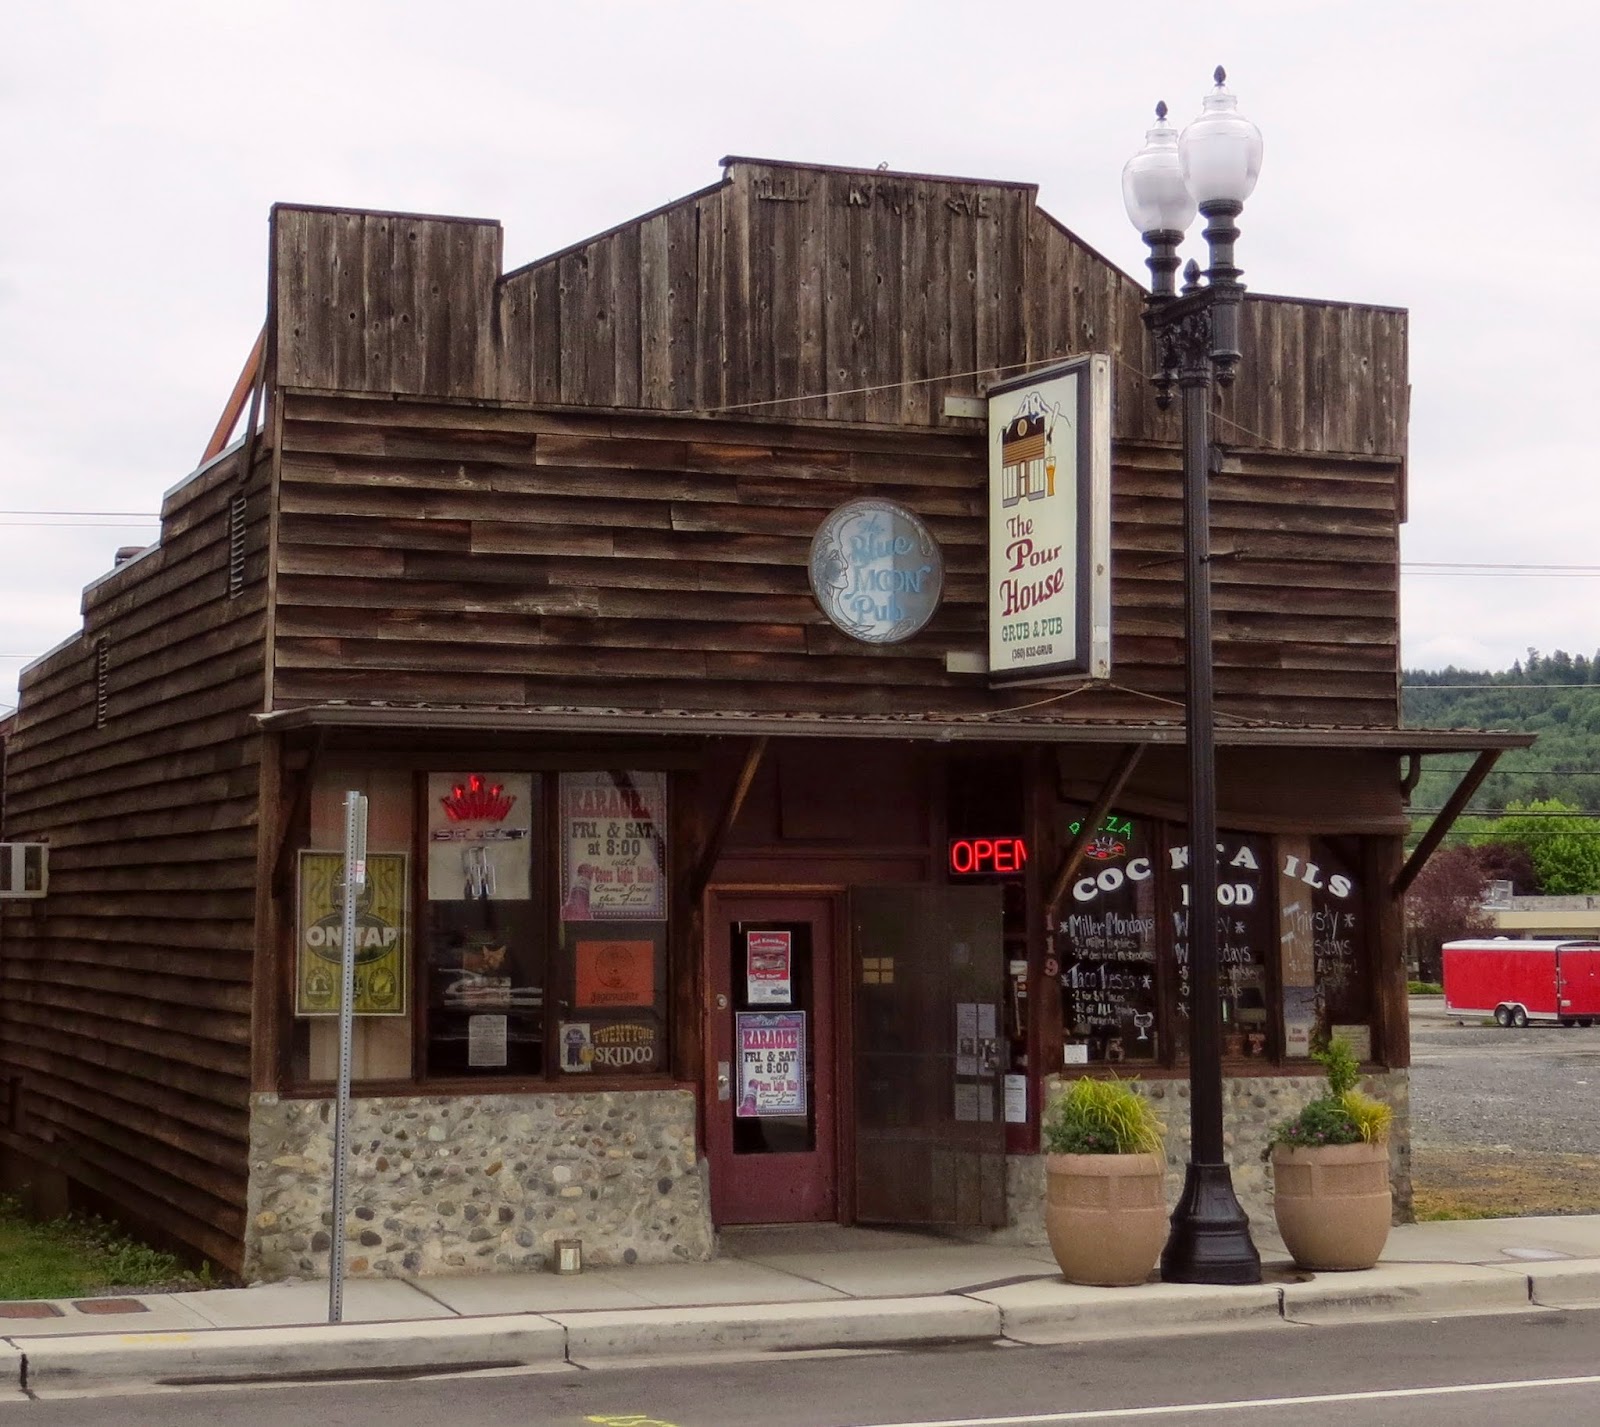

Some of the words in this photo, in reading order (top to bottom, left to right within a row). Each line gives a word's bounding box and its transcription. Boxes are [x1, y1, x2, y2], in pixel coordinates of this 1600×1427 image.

[1006, 513, 1034, 539] The
[849, 533, 913, 567] Blue
[1005, 538, 1063, 573] Pour
[999, 566, 1065, 617] House
[850, 594, 906, 626] Pub
[1001, 621, 1030, 642] GRUB
[1032, 620, 1043, 638] &
[1041, 617, 1063, 637] PUB
[572, 822, 601, 839] FRI.
[607, 822, 621, 839] &
[625, 822, 658, 840] SAT.
[1068, 815, 1133, 840] PZA
[588, 841, 602, 856] at
[606, 839, 641, 857] 8:00
[952, 839, 1028, 873] OPEN
[1072, 843, 1353, 902] COCKAILS
[594, 884, 625, 893] Come
[599, 893, 617, 903] the
[1181, 884, 1254, 906] OD
[1069, 914, 1105, 938] Miller
[1105, 911, 1155, 942] Mondays
[1282, 902, 1340, 939] Thirsty
[305, 926, 345, 948] ON
[354, 926, 399, 948] TAP
[1174, 942, 1252, 964] Wsdays
[1067, 962, 1096, 989] Taco
[1097, 1003, 1113, 1016] ALL
[743, 1029, 798, 1049] KARAOKE
[595, 1045, 653, 1067] SKIDOO
[744, 1051, 764, 1062] FRI.
[766, 1050, 776, 1062] &
[778, 1051, 799, 1063] SAT.
[754, 1064, 764, 1074] at
[766, 1062, 790, 1074] 8:00
[759, 1091, 780, 1099] Come
